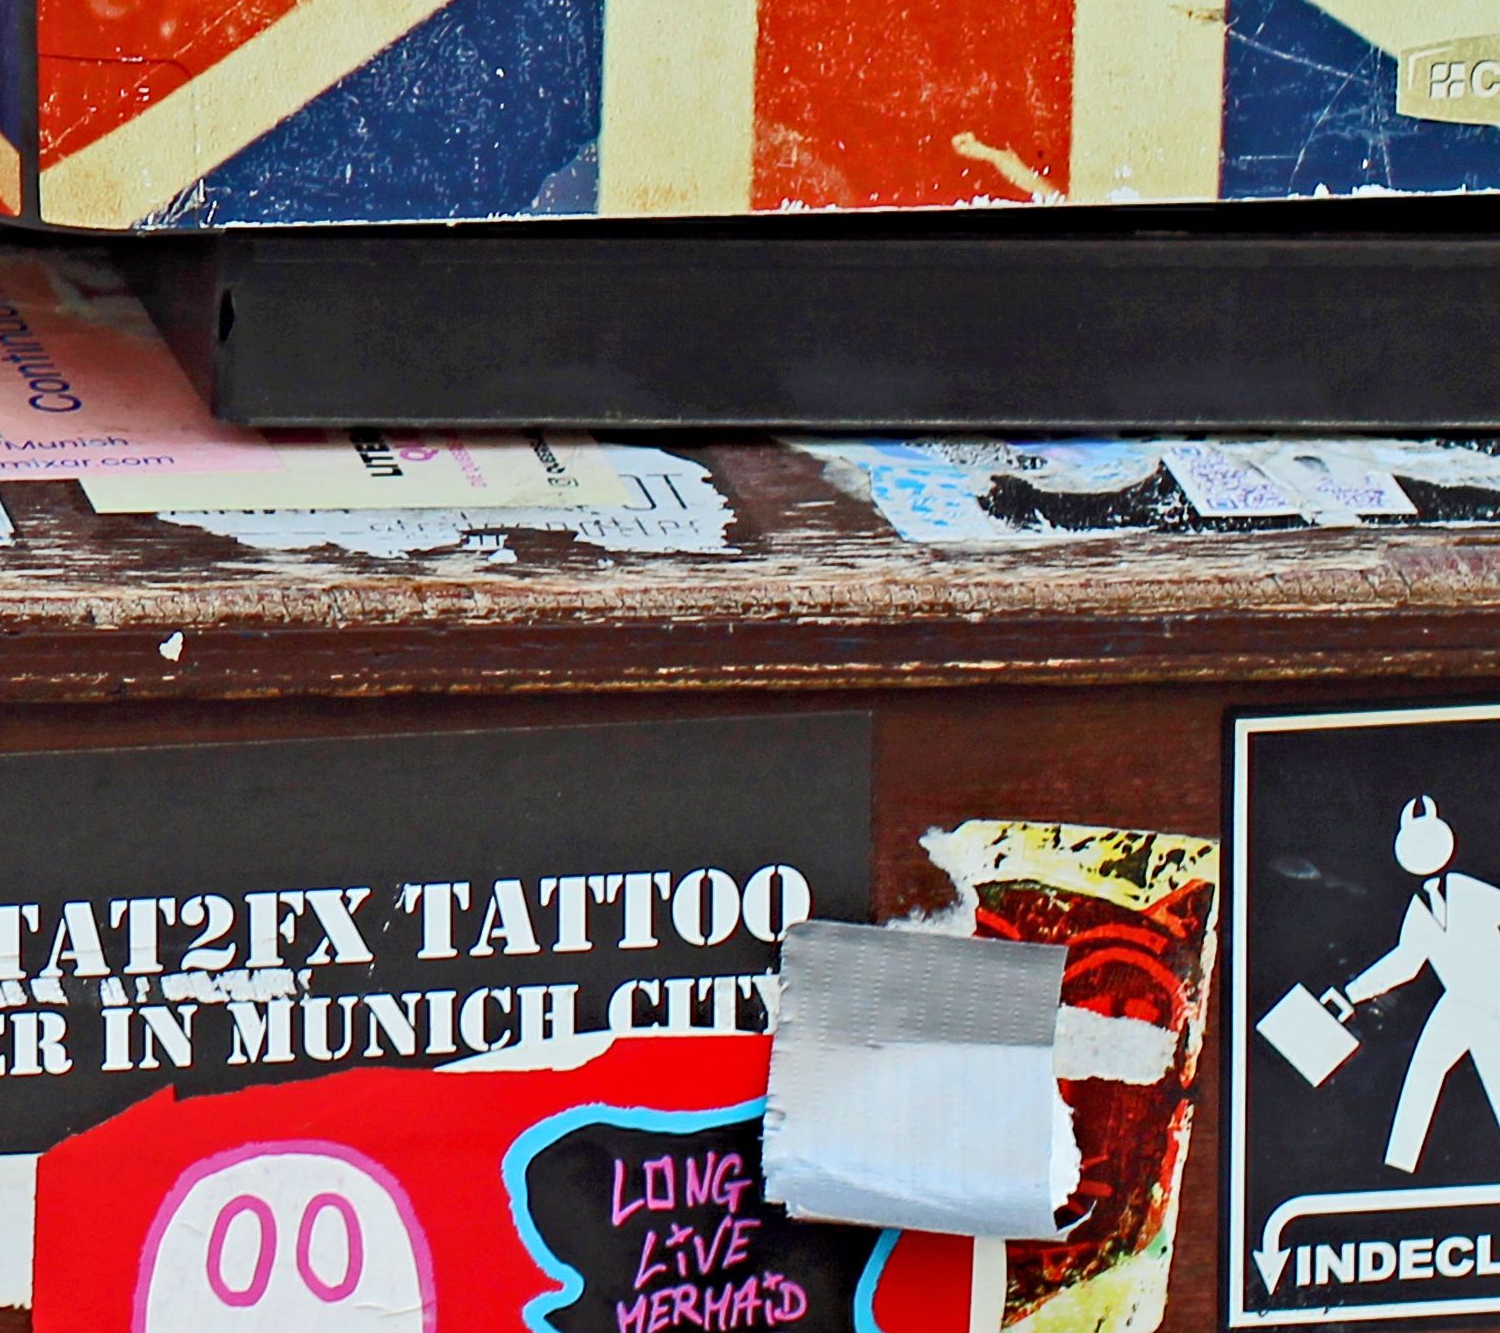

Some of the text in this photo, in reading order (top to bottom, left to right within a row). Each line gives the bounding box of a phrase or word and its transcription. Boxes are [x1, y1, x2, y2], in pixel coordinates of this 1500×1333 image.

[402, 861, 813, 964] TATTOO
[99, 1003, 195, 1074] IN
[219, 983, 594, 1069] MUNICH
[611, 1150, 754, 1227] LONG
